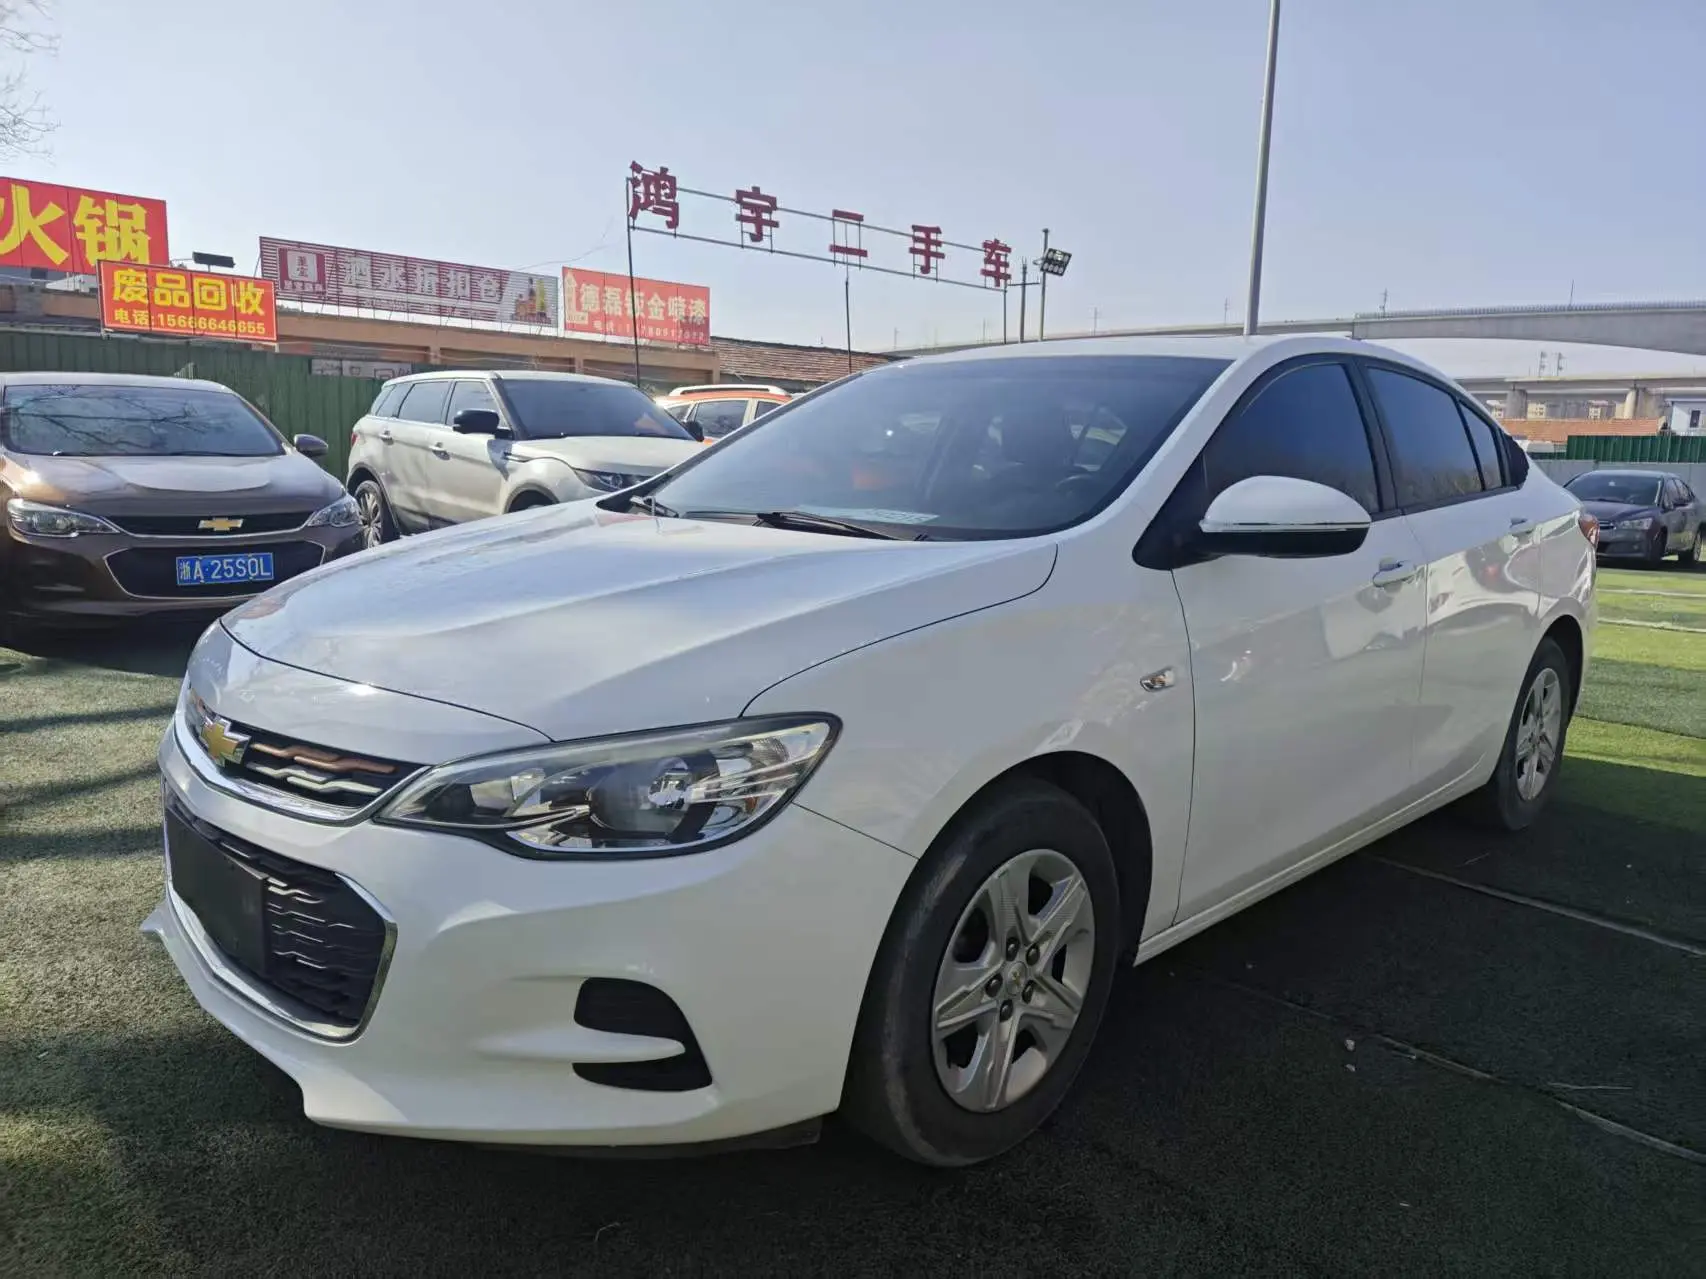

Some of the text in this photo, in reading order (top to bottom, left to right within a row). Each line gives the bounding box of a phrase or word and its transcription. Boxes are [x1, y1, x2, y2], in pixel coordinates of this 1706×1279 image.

[0, 184, 151, 266] 火锅
[629, 160, 1012, 288] 鸿宇二手车
[113, 268, 265, 317] 废品回收
